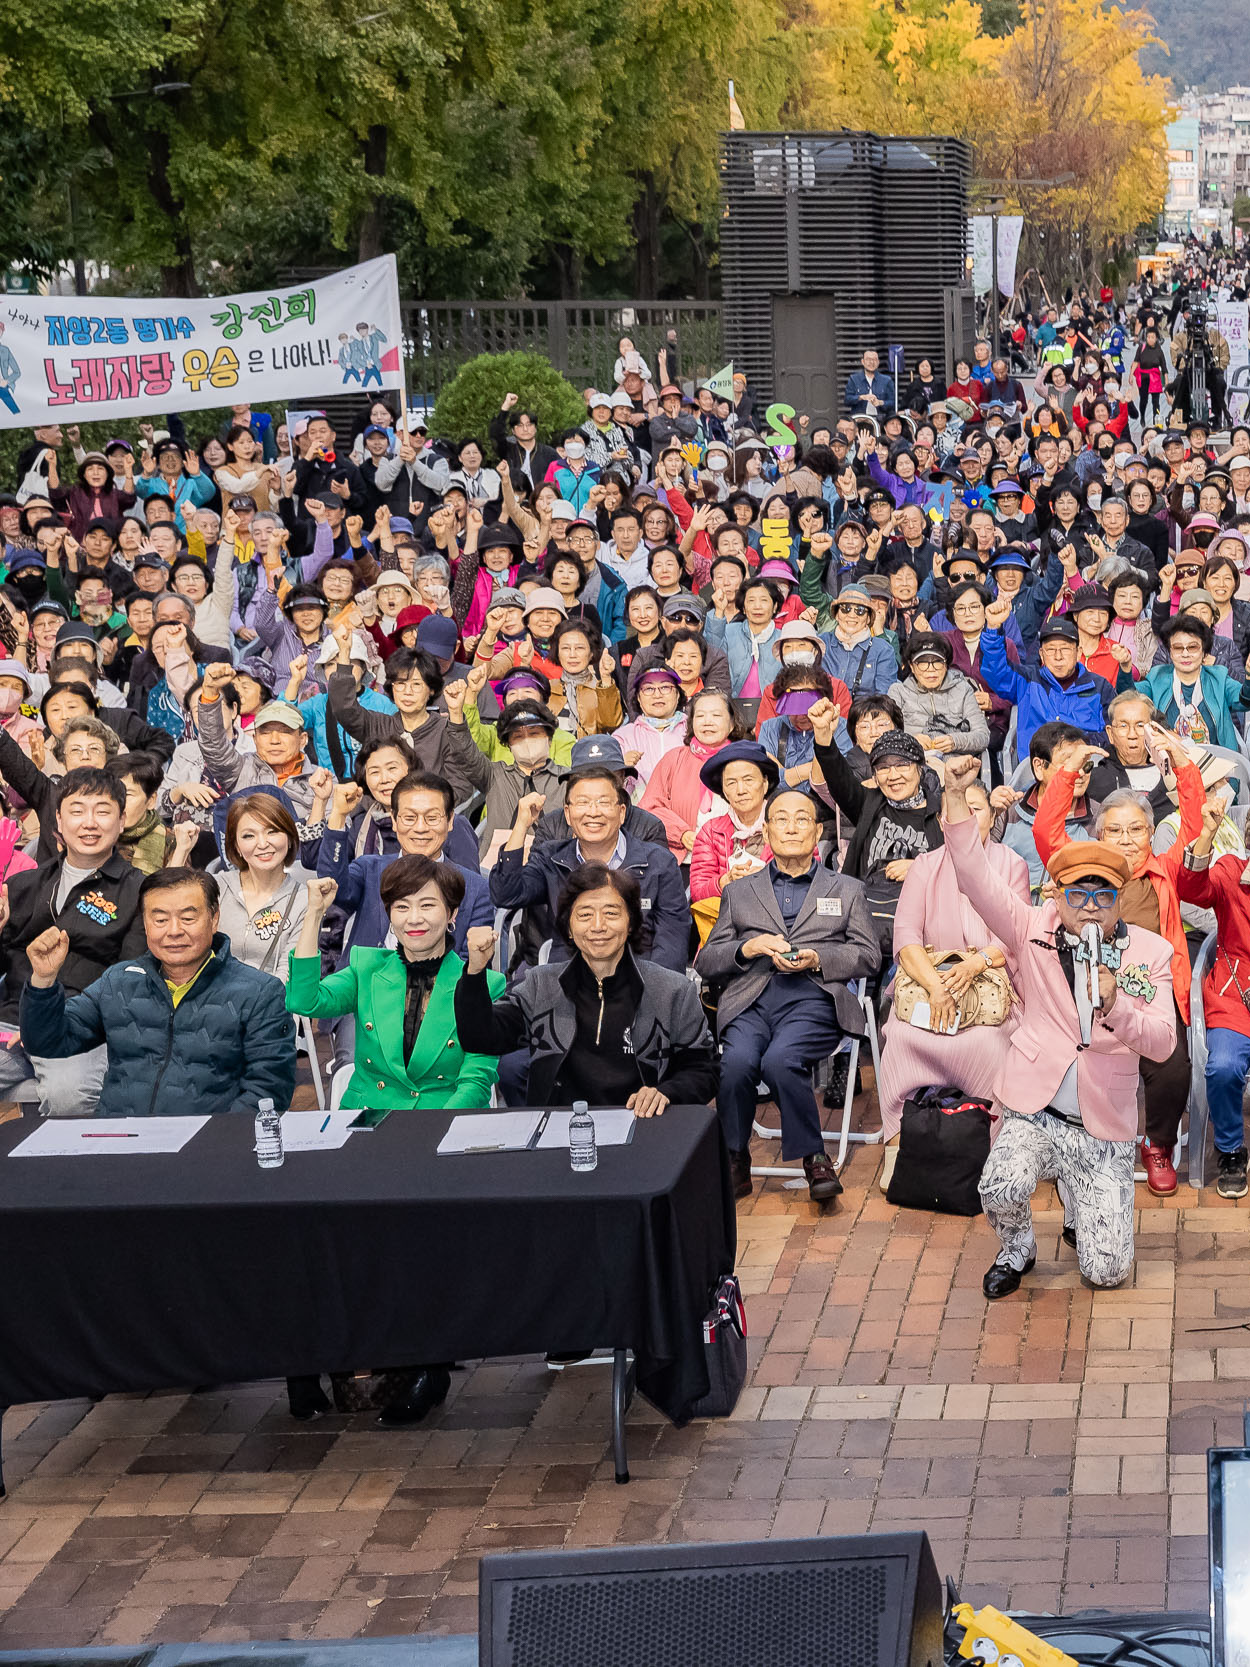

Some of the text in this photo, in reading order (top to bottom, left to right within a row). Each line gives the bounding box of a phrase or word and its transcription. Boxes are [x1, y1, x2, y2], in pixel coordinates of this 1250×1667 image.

[7, 308, 40, 331] 나야나
[44, 288, 317, 346] 자양2동 명가수 강진희
[43, 339, 333, 406] 노래자랑 우승 은 나야나!
[759, 518, 793, 560] 동
[85, 891, 118, 915] 구의원
[254, 911, 282, 930] 구의원
[1123, 963, 1151, 983] MC
